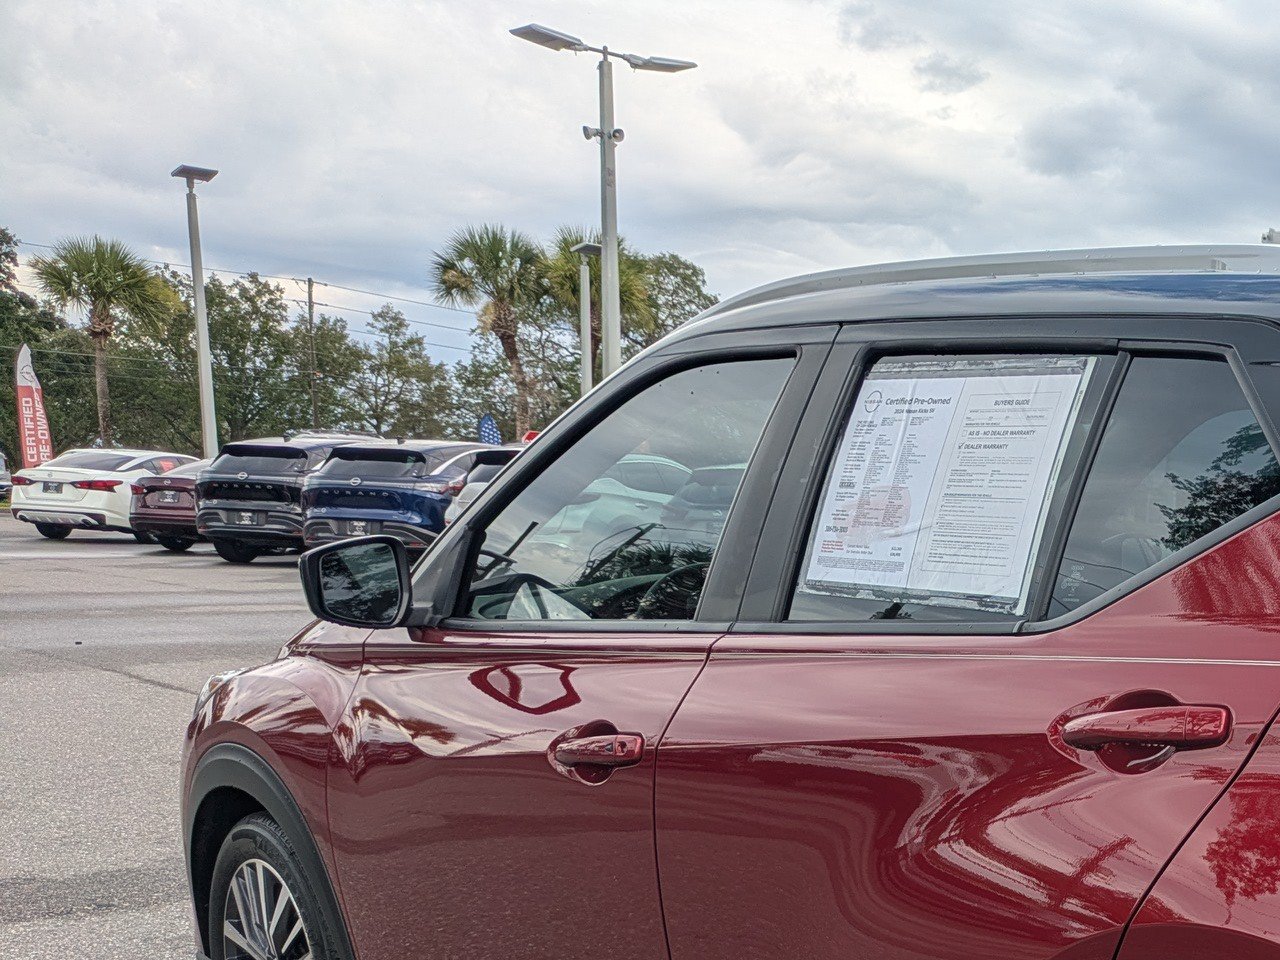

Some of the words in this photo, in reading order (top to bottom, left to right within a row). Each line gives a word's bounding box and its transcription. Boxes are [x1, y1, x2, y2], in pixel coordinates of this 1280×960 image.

[885, 396, 914, 406] Certified
[913, 396, 952, 405] Pre-Owned
[1014, 398, 1031, 406] GUIDE
[22, 397, 37, 462] CERTIFIED
[323, 489, 389, 497] MURANO
